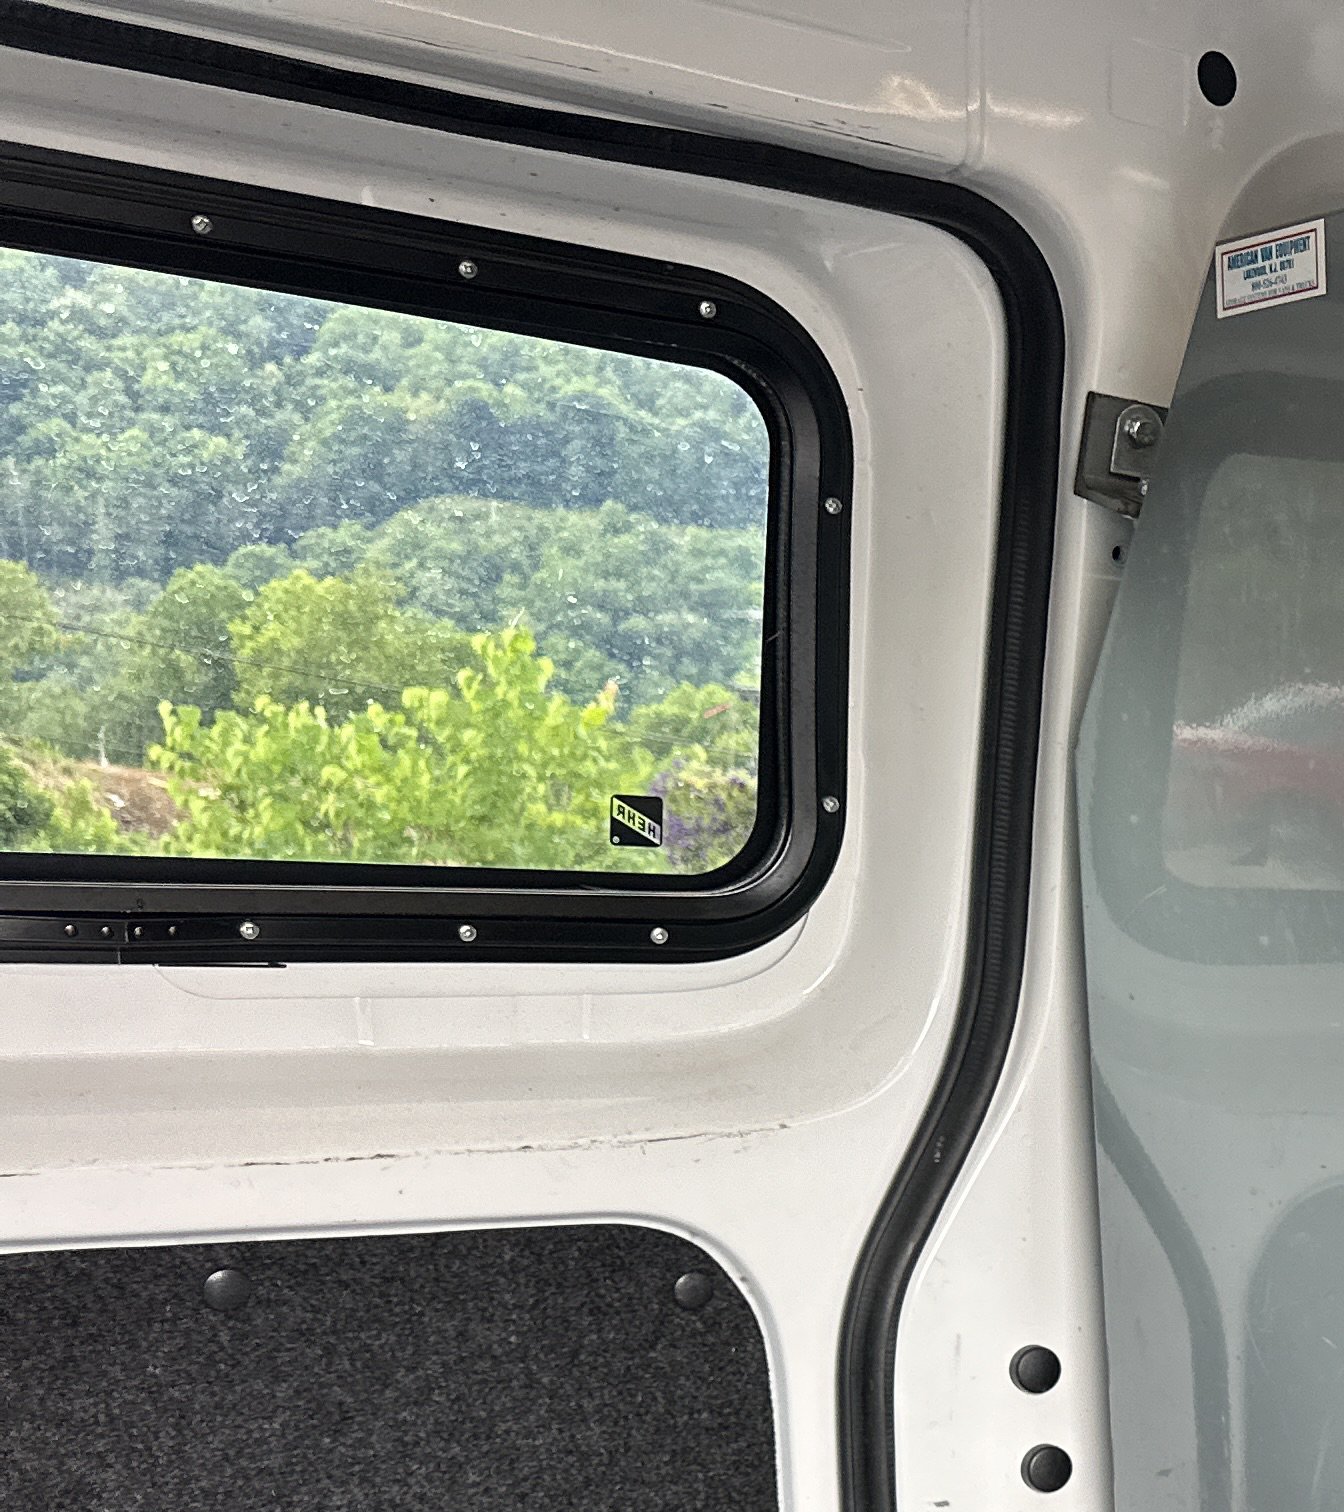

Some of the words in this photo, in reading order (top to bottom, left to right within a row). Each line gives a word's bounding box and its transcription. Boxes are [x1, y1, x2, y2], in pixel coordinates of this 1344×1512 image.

[1228, 250, 1258, 270] AMERICAN
[1260, 245, 1273, 262] VAN
[1275, 236, 1310, 259] EQUIPMENT
